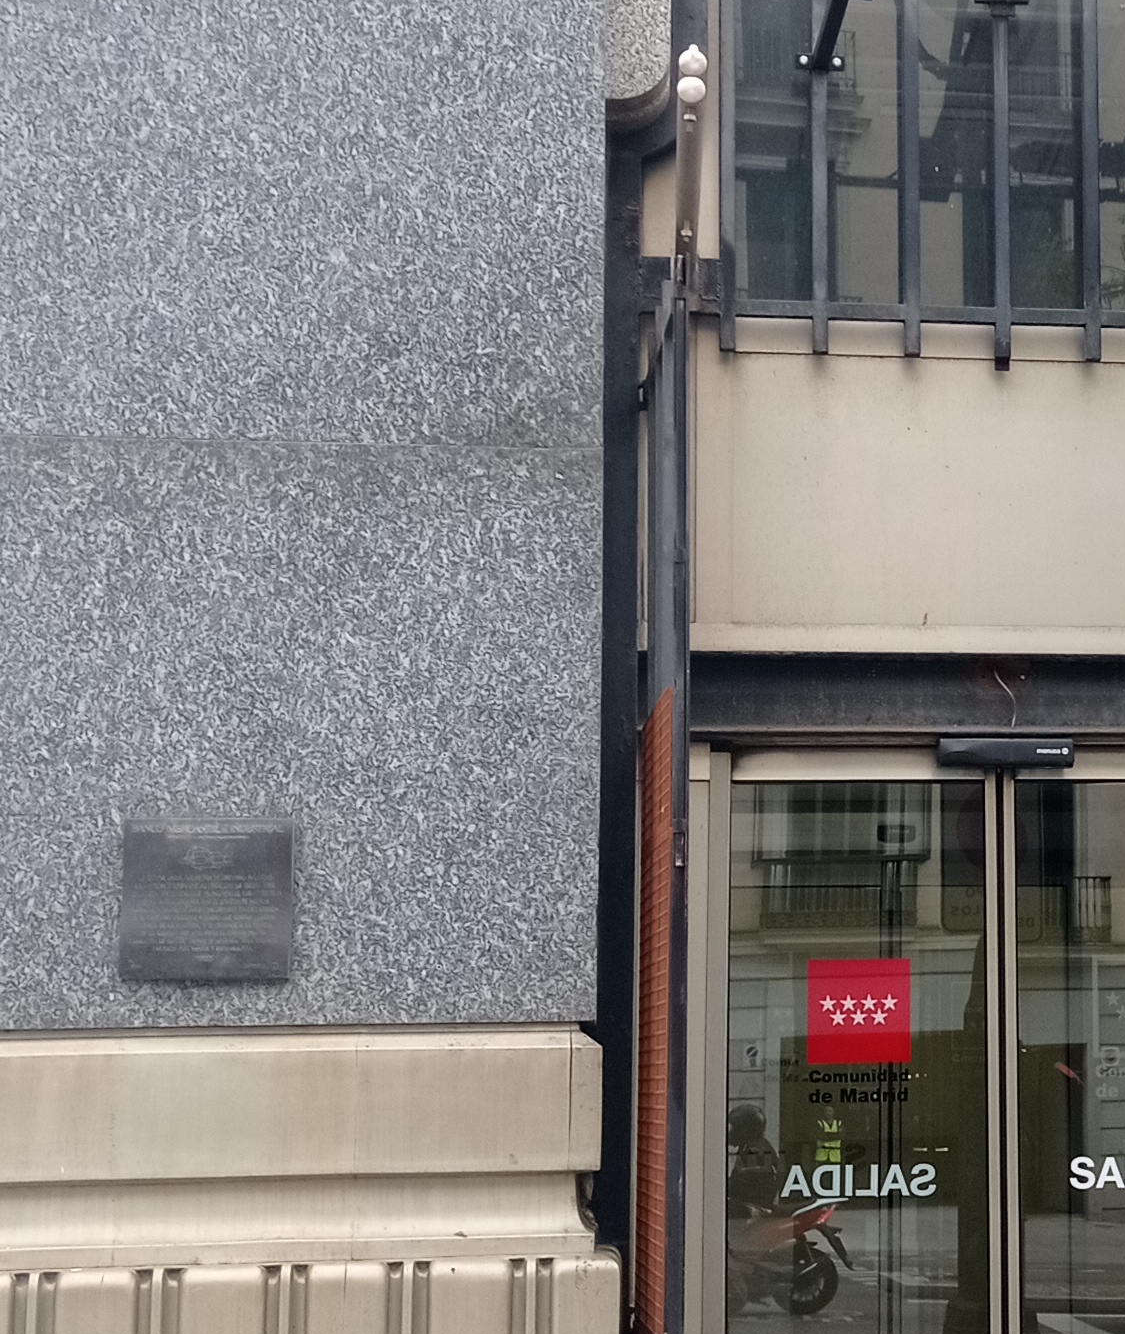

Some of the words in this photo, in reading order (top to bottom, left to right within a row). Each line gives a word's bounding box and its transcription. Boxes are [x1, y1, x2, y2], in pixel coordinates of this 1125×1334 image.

[808, 1069, 910, 1083] Comunidad
[808, 1089, 833, 1103] de
[840, 1088, 909, 1103] Madrid
[1095, 1083, 1119, 1098] de
